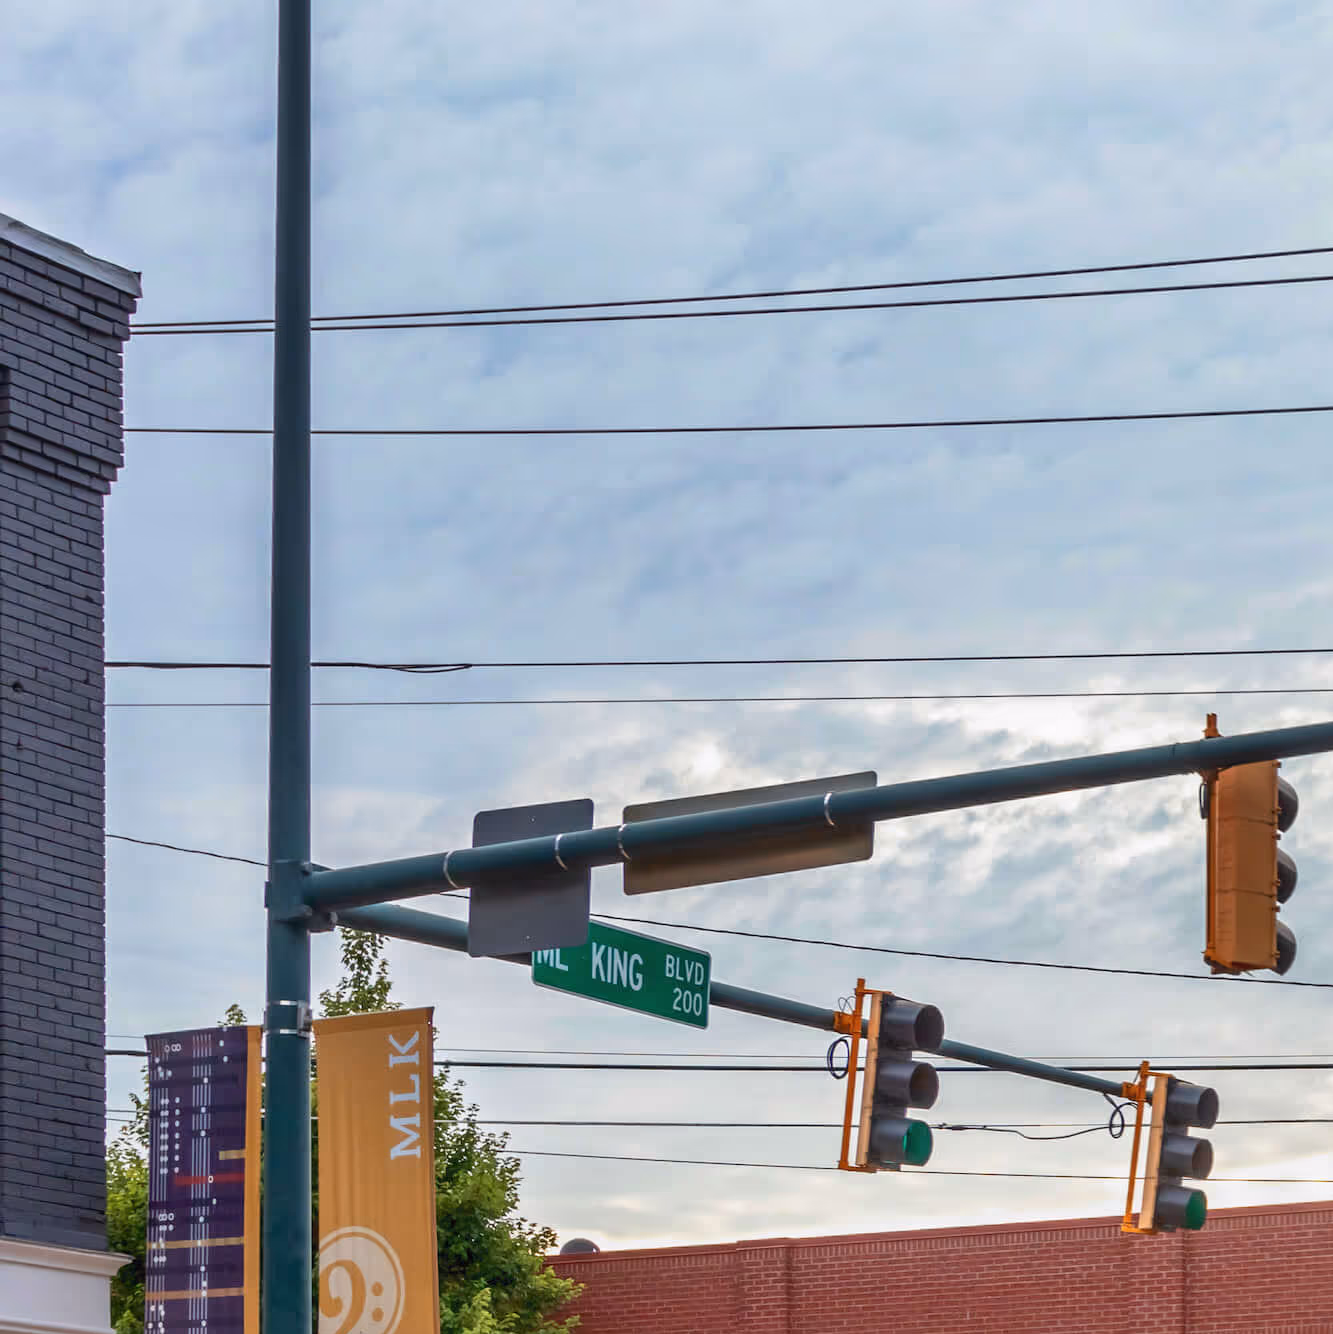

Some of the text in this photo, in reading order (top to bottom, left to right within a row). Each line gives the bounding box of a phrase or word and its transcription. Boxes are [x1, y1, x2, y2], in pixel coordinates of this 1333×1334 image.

[591, 942, 644, 991] KING
[665, 954, 704, 986] BLVD
[672, 987, 702, 1017] 200
[388, 1030, 421, 1160] MLK
